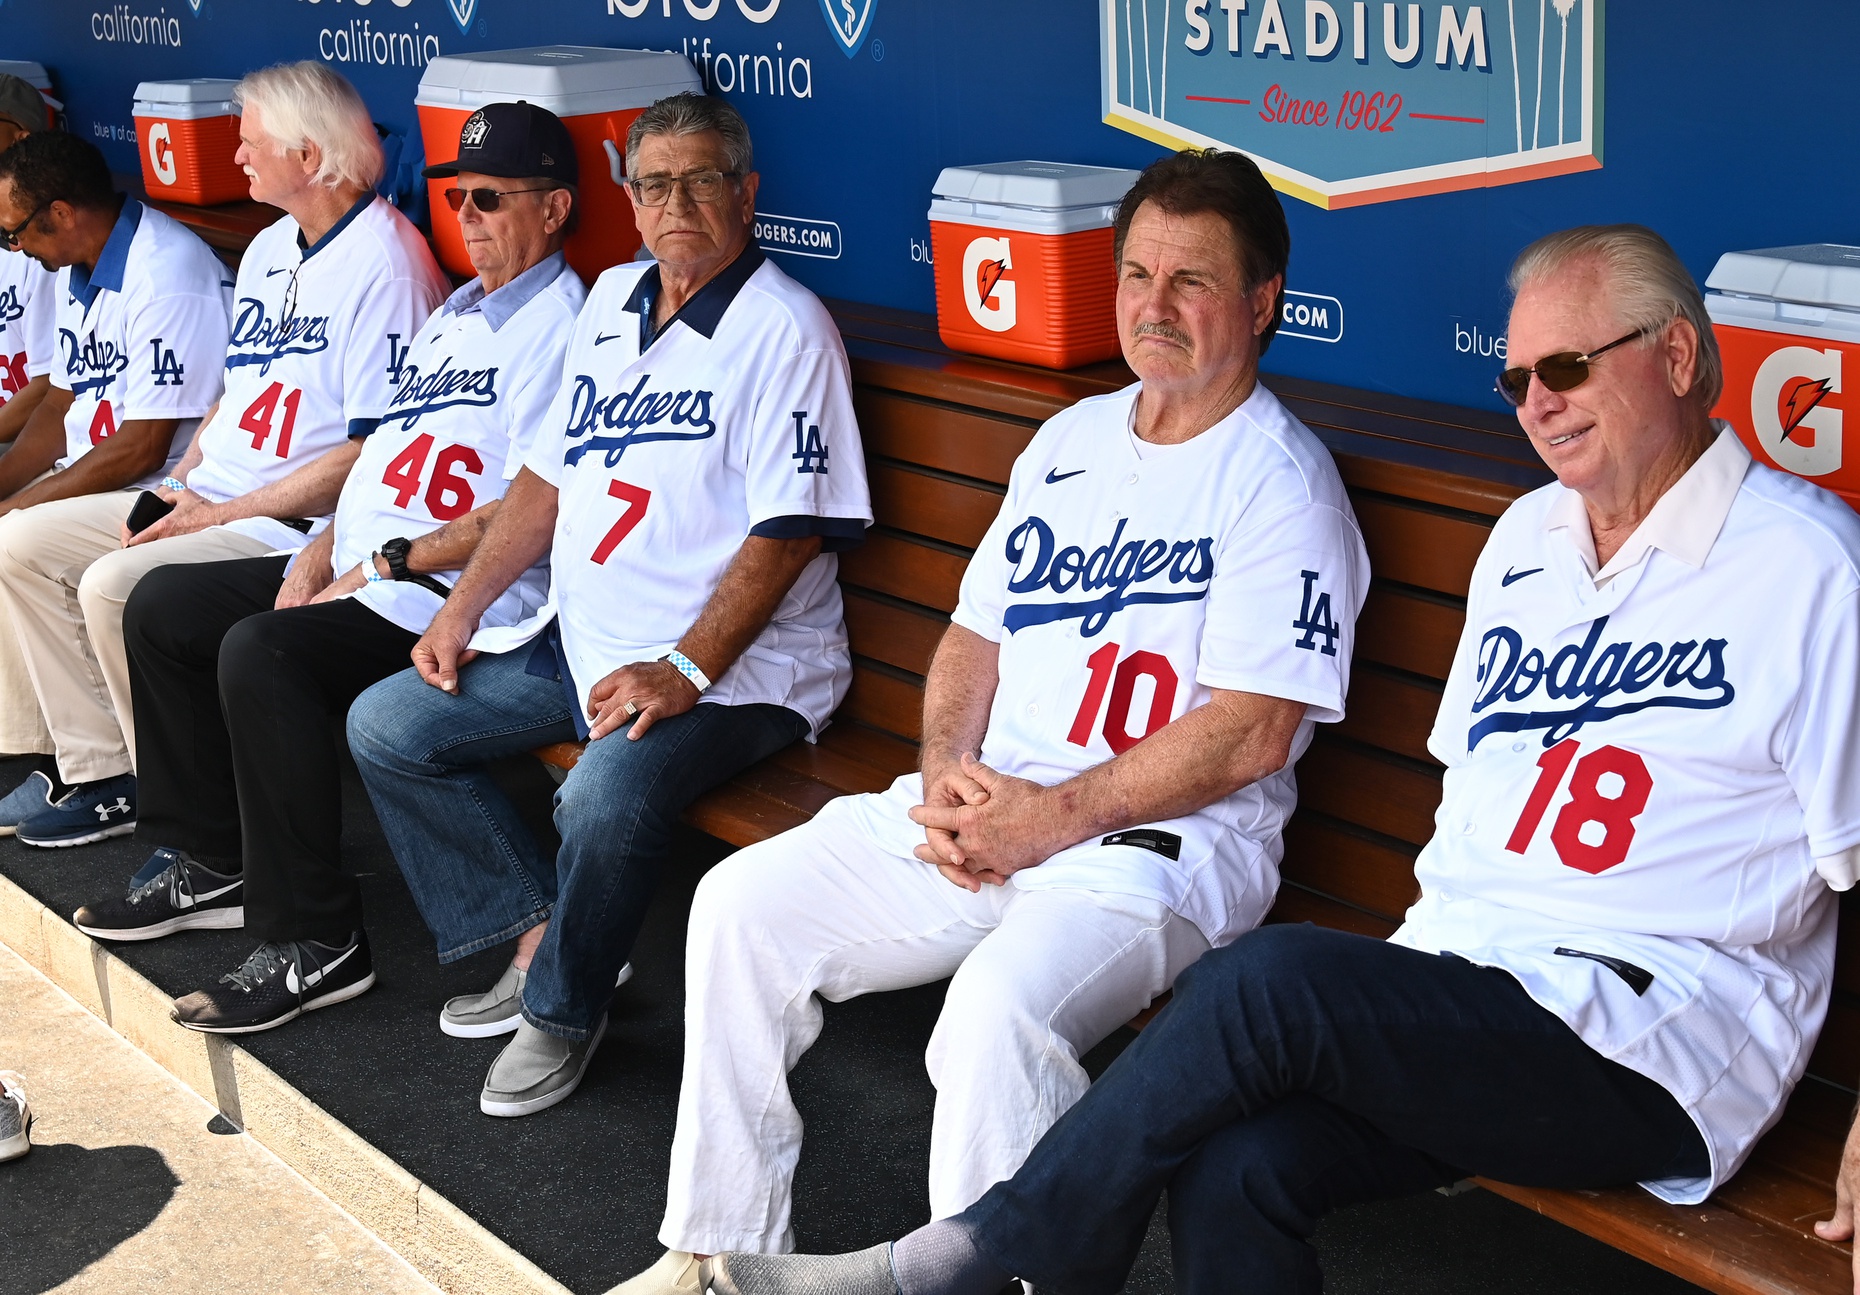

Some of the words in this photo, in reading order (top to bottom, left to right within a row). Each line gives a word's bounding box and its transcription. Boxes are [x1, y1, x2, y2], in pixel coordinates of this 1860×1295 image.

[91, 5, 182, 47] california
[319, 19, 441, 67] california
[1184, 0, 1488, 70] STADIUM
[642, 37, 812, 98] ifornia
[93, 121, 110, 138] blue
[1258, 84, 1329, 127] Since
[1335, 90, 1403, 132] 1962
[148, 122, 177, 186] G
[751, 222, 832, 248] DGERS.COM
[962, 236, 1018, 333] G
[150, 338, 184, 385] LA
[1455, 322, 1508, 360] blue
[238, 381, 302, 459] 41
[377, 356, 499, 432] Dodgers
[564, 374, 716, 468] Dodgers
[1751, 346, 1843, 477] G
[381, 432, 484, 521] 46
[792, 411, 829, 474] LA
[590, 478, 651, 565] 7
[1003, 516, 1214, 637] Dodgers
[1293, 569, 1339, 657] LA
[1066, 641, 1179, 756] 10
[1467, 615, 1735, 758] Dodgers
[1504, 738, 1654, 875] 18
